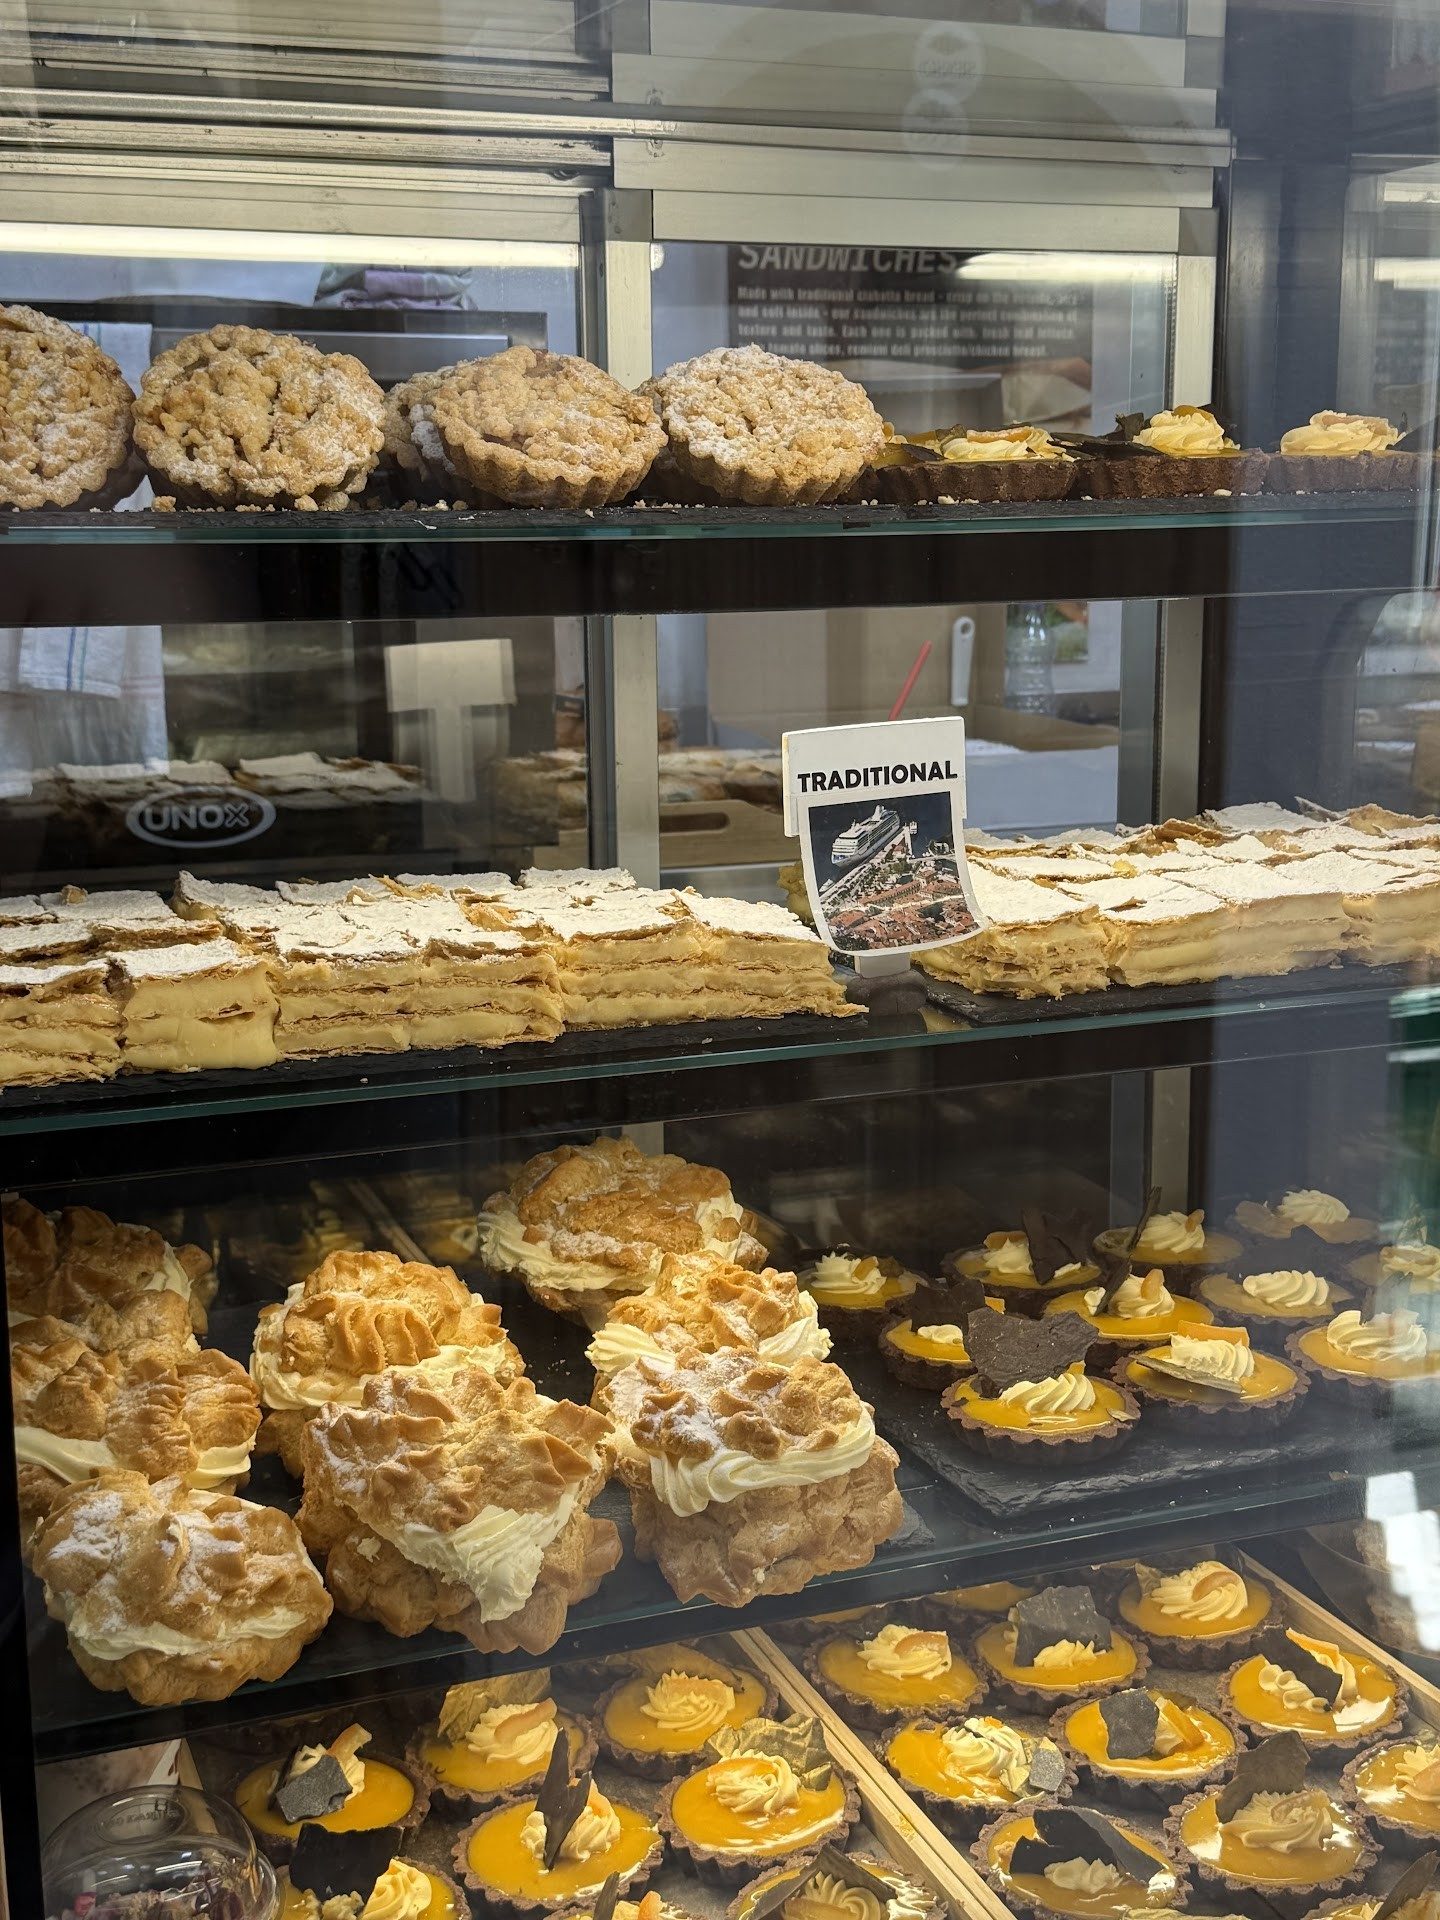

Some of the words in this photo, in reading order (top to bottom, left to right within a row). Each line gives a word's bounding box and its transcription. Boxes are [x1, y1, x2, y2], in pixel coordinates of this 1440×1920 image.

[738, 246, 957, 272] SANDWICHES
[798, 760, 958, 793] TRADITIONAL
[145, 803, 250, 831] UNOX
